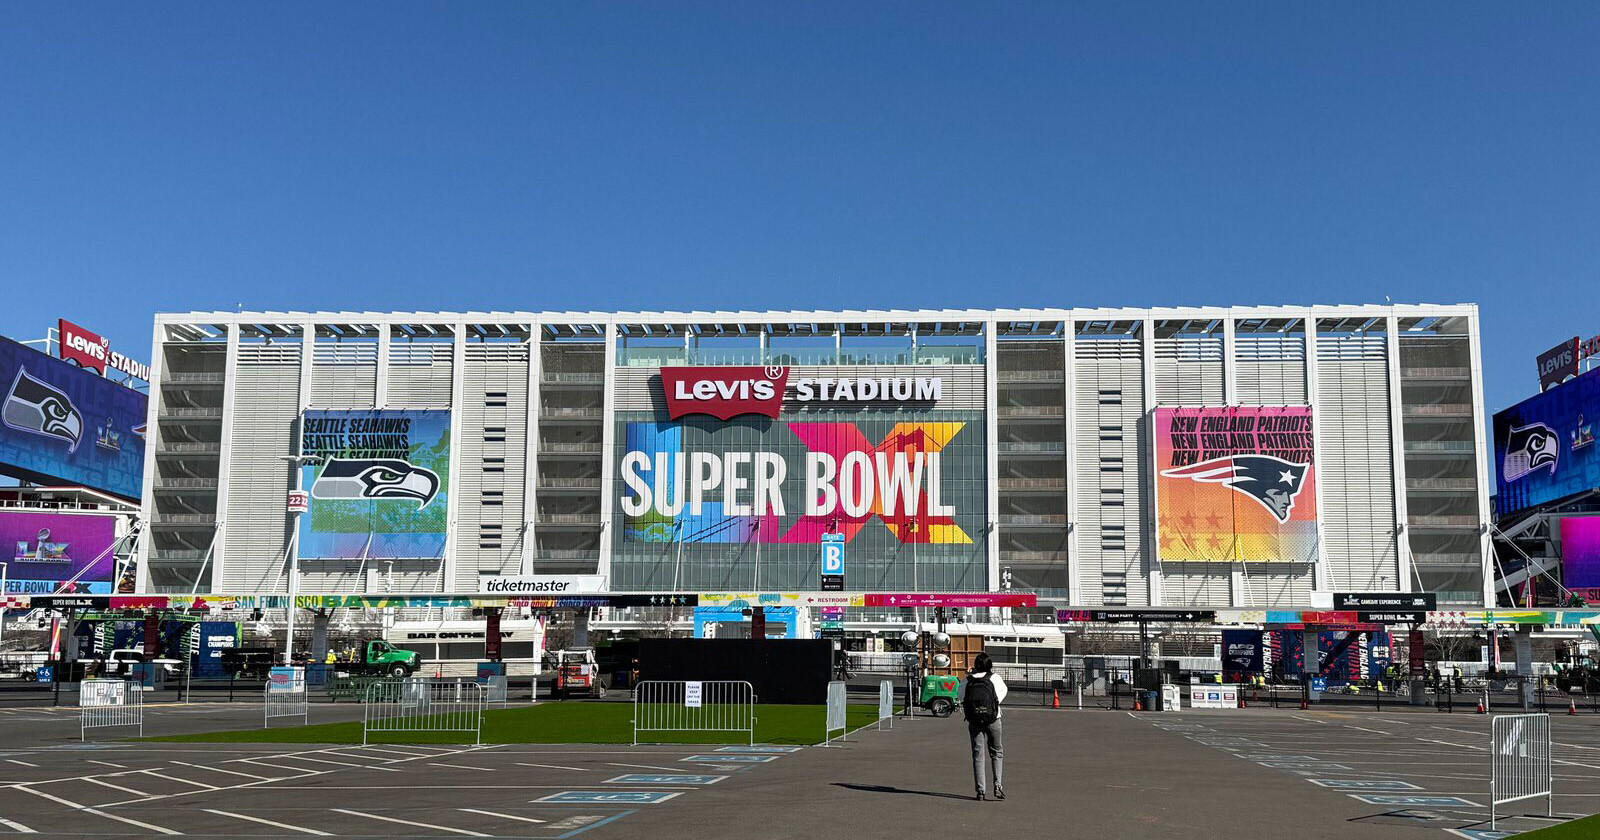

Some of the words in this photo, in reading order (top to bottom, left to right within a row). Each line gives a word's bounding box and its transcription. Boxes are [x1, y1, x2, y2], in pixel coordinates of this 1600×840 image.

[111, 351, 150, 383] STADIU
[796, 377, 942, 401] STADIUM
[303, 418, 347, 434] SEATTLE
[349, 418, 411, 434] SEAHAWKS
[1170, 416, 1199, 432] NEW
[1200, 416, 1256, 432] ENGLAND
[1257, 416, 1313, 433] PATRIOTS
[302, 434, 346, 450] SEATTLE
[348, 434, 410, 450] SEAHAWKS
[1171, 433, 1199, 449] NEW
[1201, 433, 1256, 449] ENGLAND
[1258, 433, 1314, 450] PATRIOTS
[1171, 450, 1200, 466] NEW
[621, 451, 787, 516] SUPER
[806, 451, 956, 516] BOWL
[289, 496, 301, 505] 22
[826, 545, 841, 571] B
[5, 581, 21, 593] PER
[24, 581, 51, 593] BOWL
[486, 578, 570, 592] ticketmaster
[235, 595, 255, 608] SAN
[94, 622, 104, 655] SEATTLE
[191, 622, 200, 656] SEATTLE
